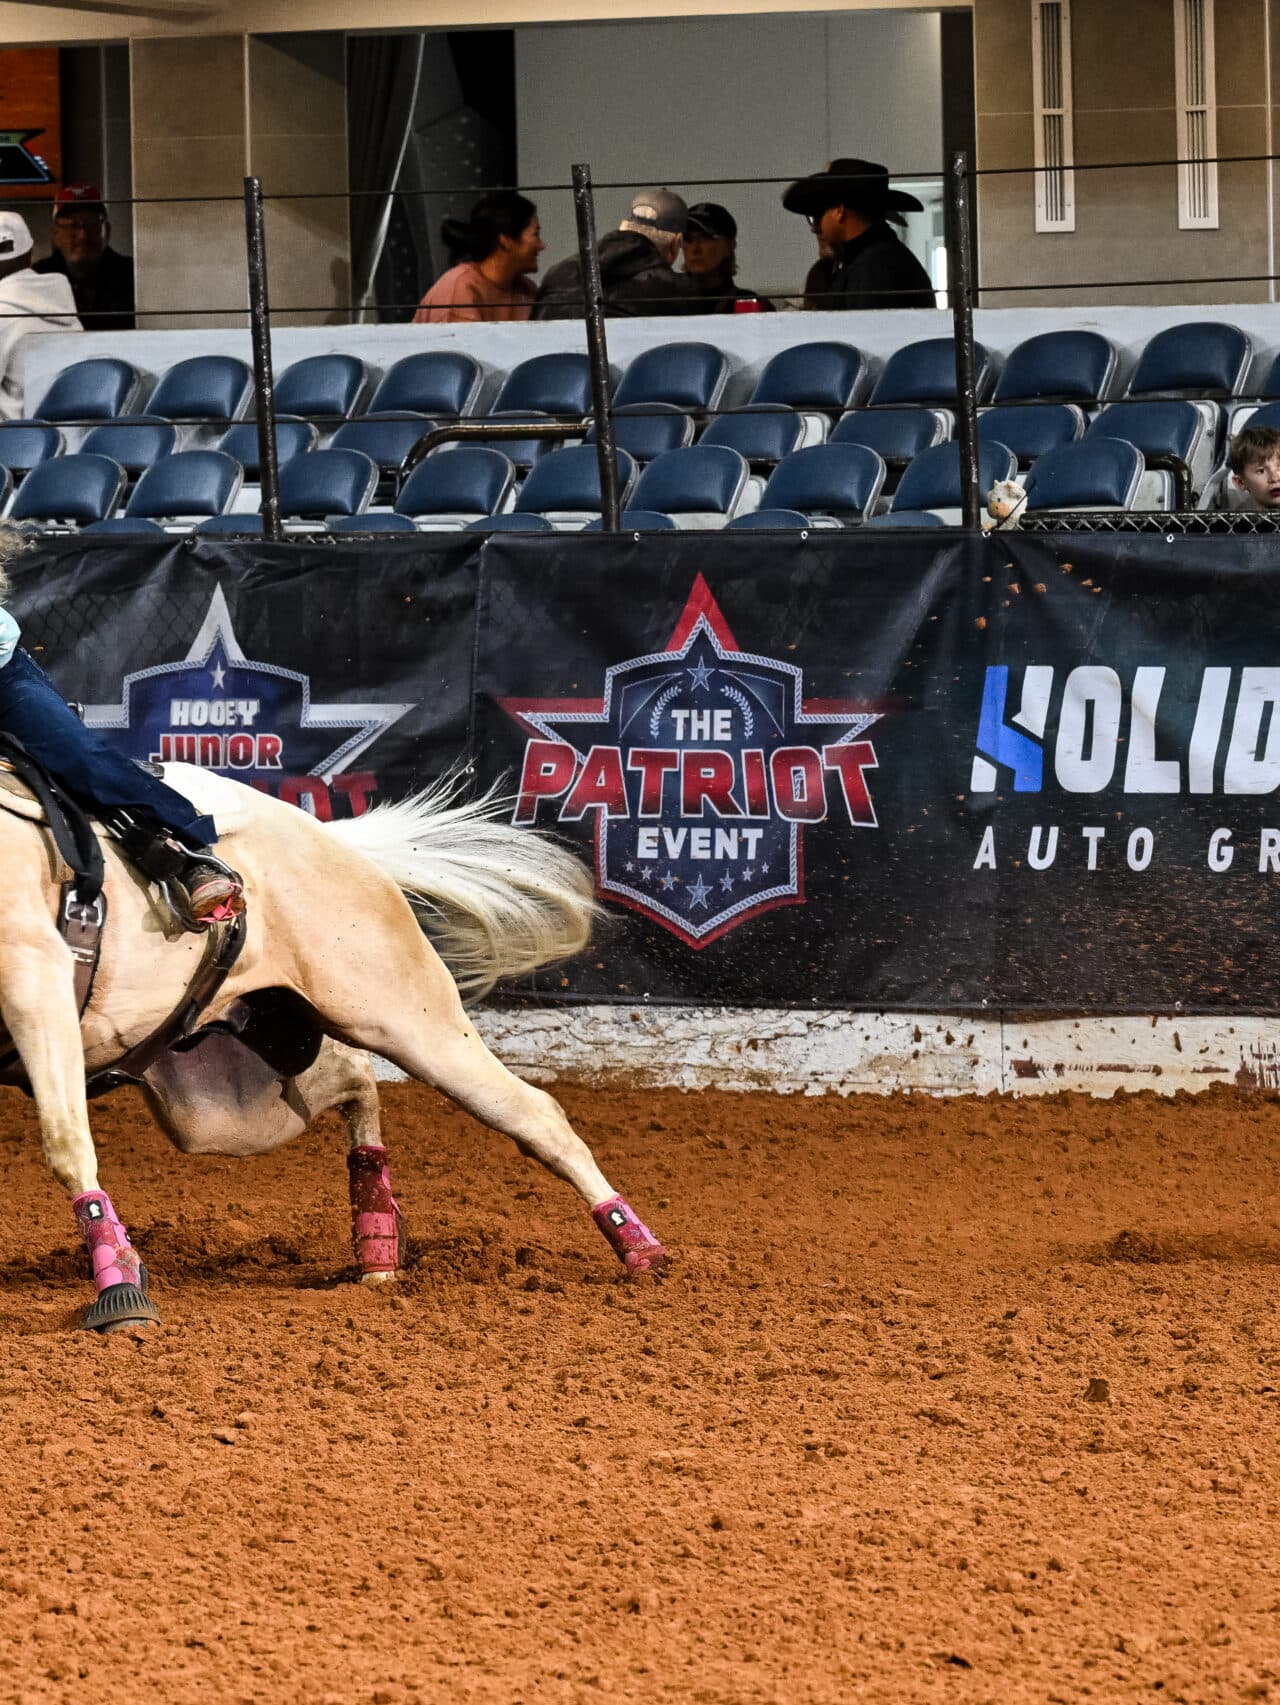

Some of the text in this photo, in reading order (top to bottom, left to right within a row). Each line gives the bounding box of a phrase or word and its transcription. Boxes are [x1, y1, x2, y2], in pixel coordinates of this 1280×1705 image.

[170, 699, 261, 727] HOOEY
[671, 709, 732, 741] THE
[511, 739, 880, 828] PATRIOT
[637, 827, 763, 860] EVENT
[973, 825, 1154, 872] AUTO
